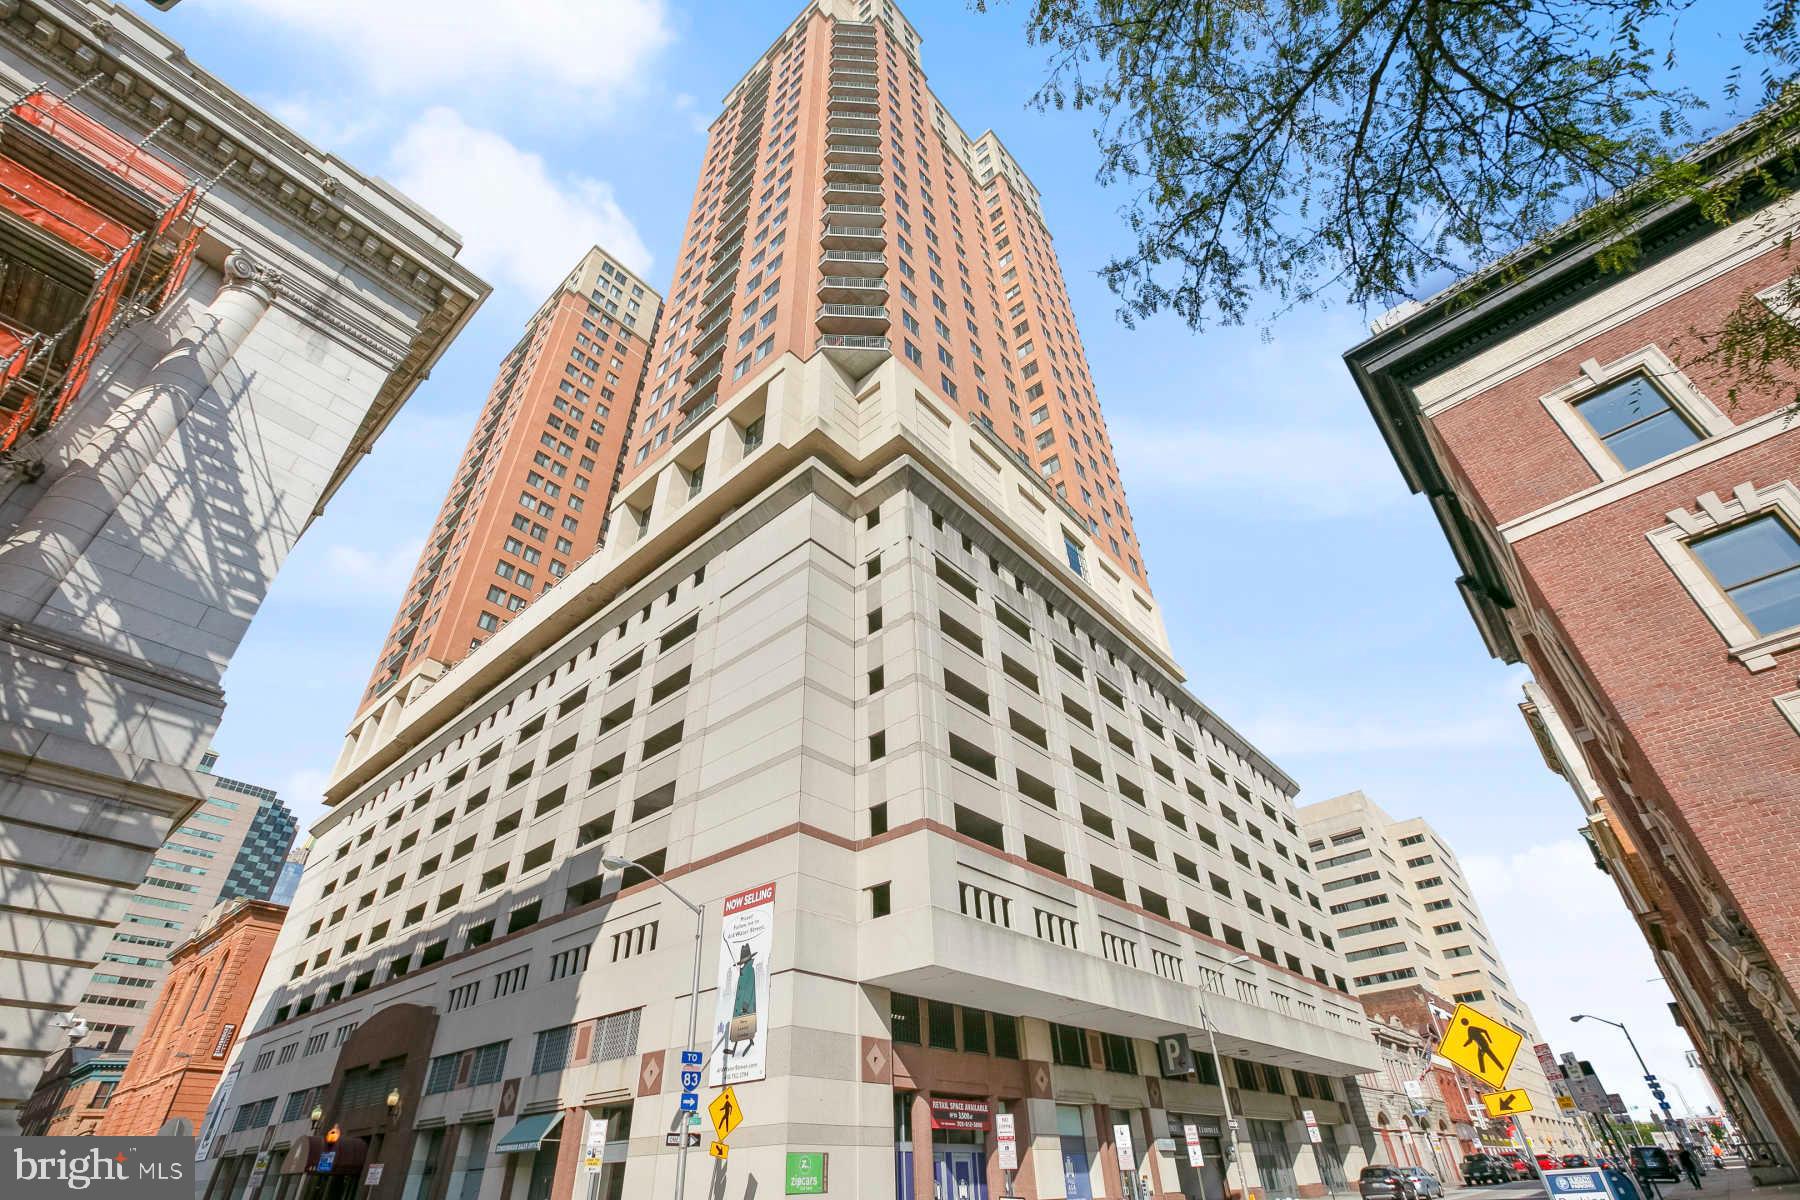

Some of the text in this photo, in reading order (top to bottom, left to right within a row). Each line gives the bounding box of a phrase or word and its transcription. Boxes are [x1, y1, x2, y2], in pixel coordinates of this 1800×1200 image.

[726, 888, 772, 911] NOW SELLING
[688, 1053, 698, 1061] TO
[1164, 1039, 1180, 1071] P
[683, 1073, 699, 1086] 83
[932, 1101, 989, 1112] RETAIL SPACE AVAILABLE
